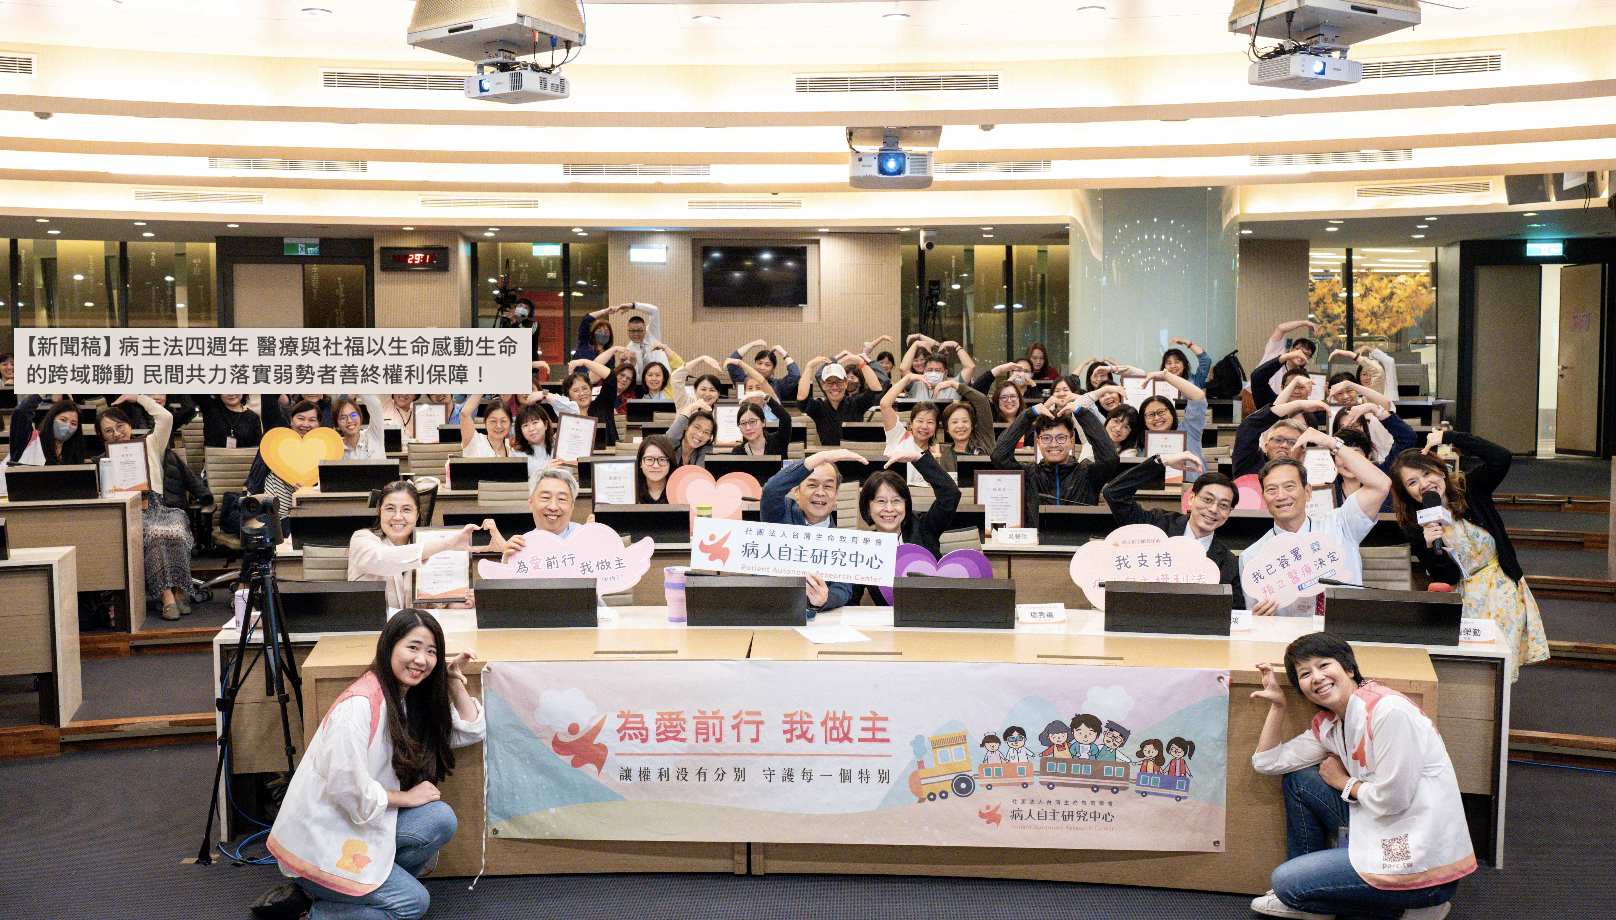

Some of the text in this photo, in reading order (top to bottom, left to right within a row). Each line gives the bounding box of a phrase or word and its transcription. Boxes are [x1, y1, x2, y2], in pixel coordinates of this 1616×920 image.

[515, 553, 627, 575] 為愛前行 我做主
[741, 541, 883, 569] 病人自主研究中心
[1115, 551, 1172, 570] 我支持
[741, 564, 770, 573] Patient
[854, 574, 882, 582] Center
[616, 709, 891, 745] 為愛前行 我做主
[1010, 808, 1115, 822] 病人自主研究中心
